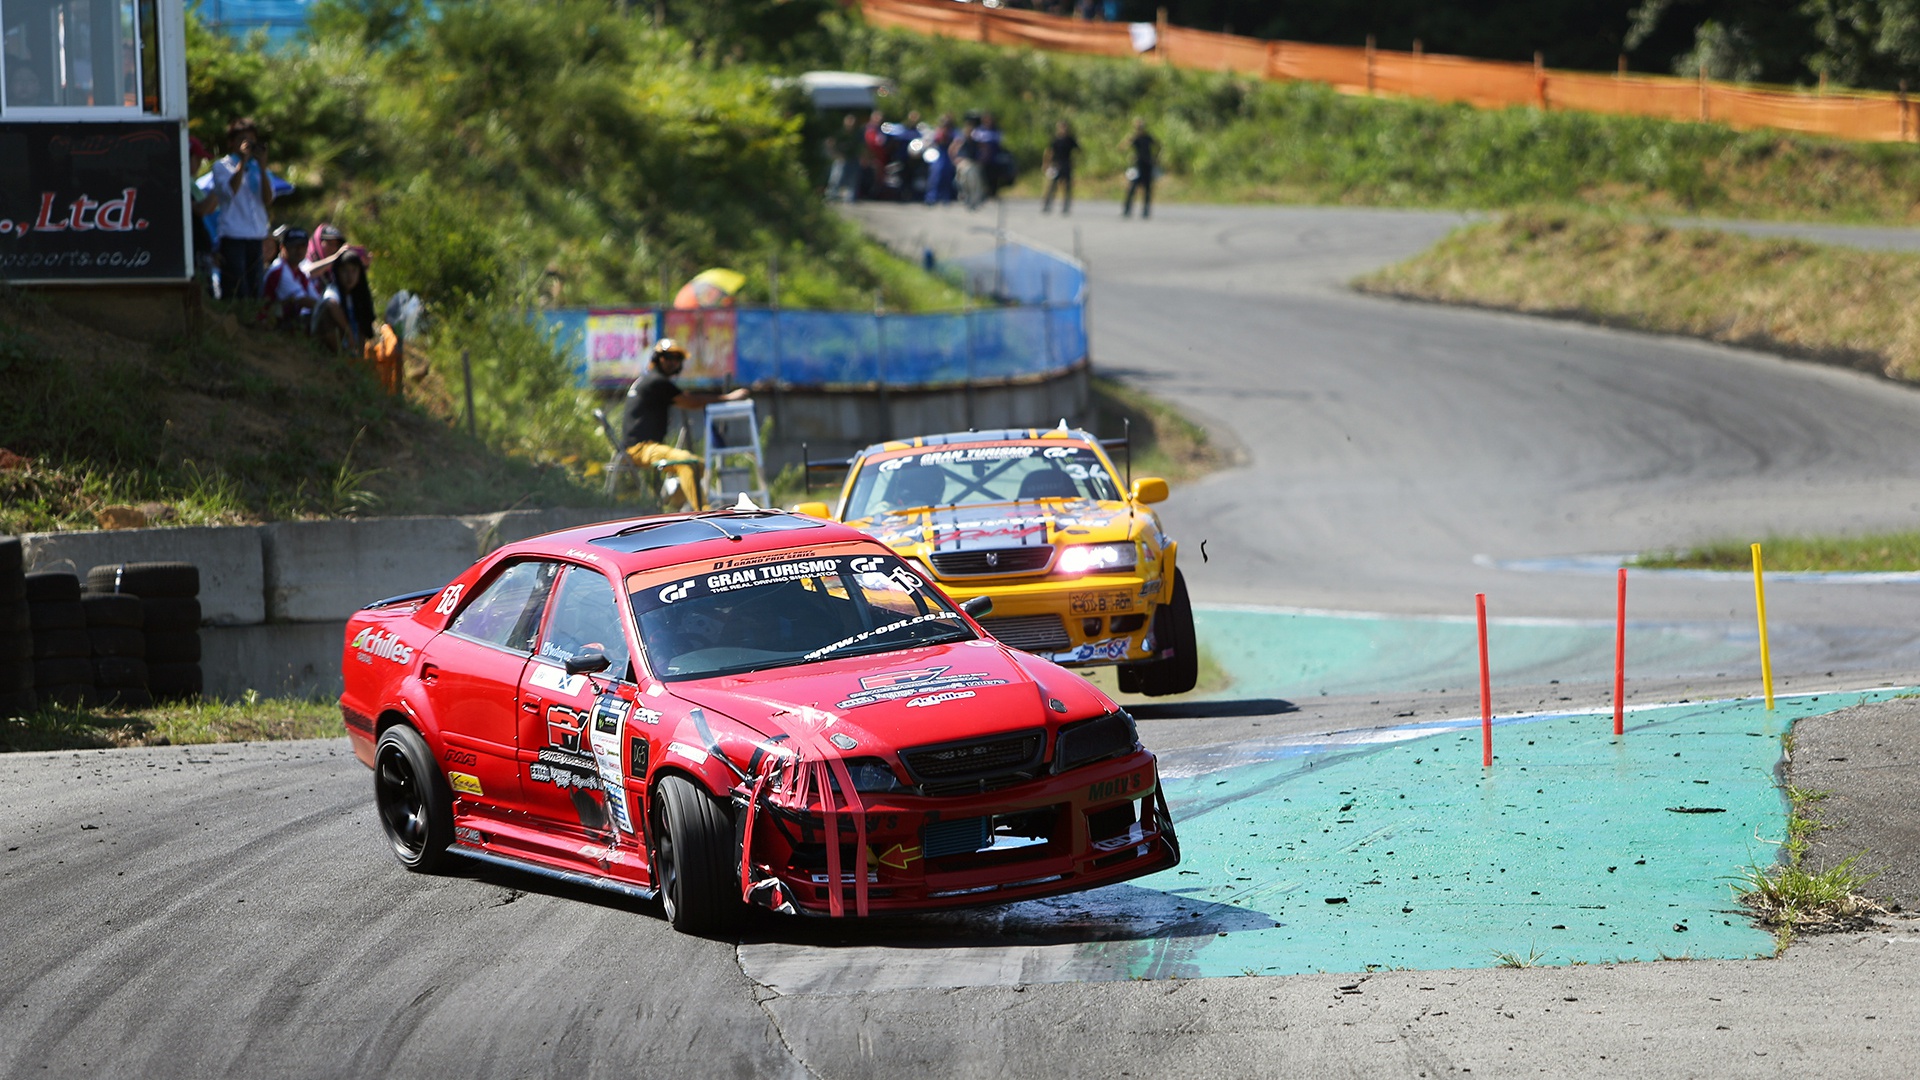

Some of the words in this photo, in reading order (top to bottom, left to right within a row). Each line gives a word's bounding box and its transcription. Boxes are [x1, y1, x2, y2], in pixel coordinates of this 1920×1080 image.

[920, 450, 964, 462] GRAN
[1065, 464, 1110, 481] 34
[713, 560, 733, 570] D1
[733, 558, 764, 567] GRAND
[764, 555, 785, 563] PRIX
[786, 552, 816, 560] SERIES
[707, 569, 757, 589] GRAN
[730, 583, 754, 591] REAL
[754, 577, 789, 587] DRIVING
[788, 571, 839, 582] SIMULATOR
[352, 626, 414, 665] Achilles
[803, 611, 962, 660] www.v-opt.co.jp
[906, 690, 976, 708] Achilles
[1088, 772, 1141, 801] Moty's
